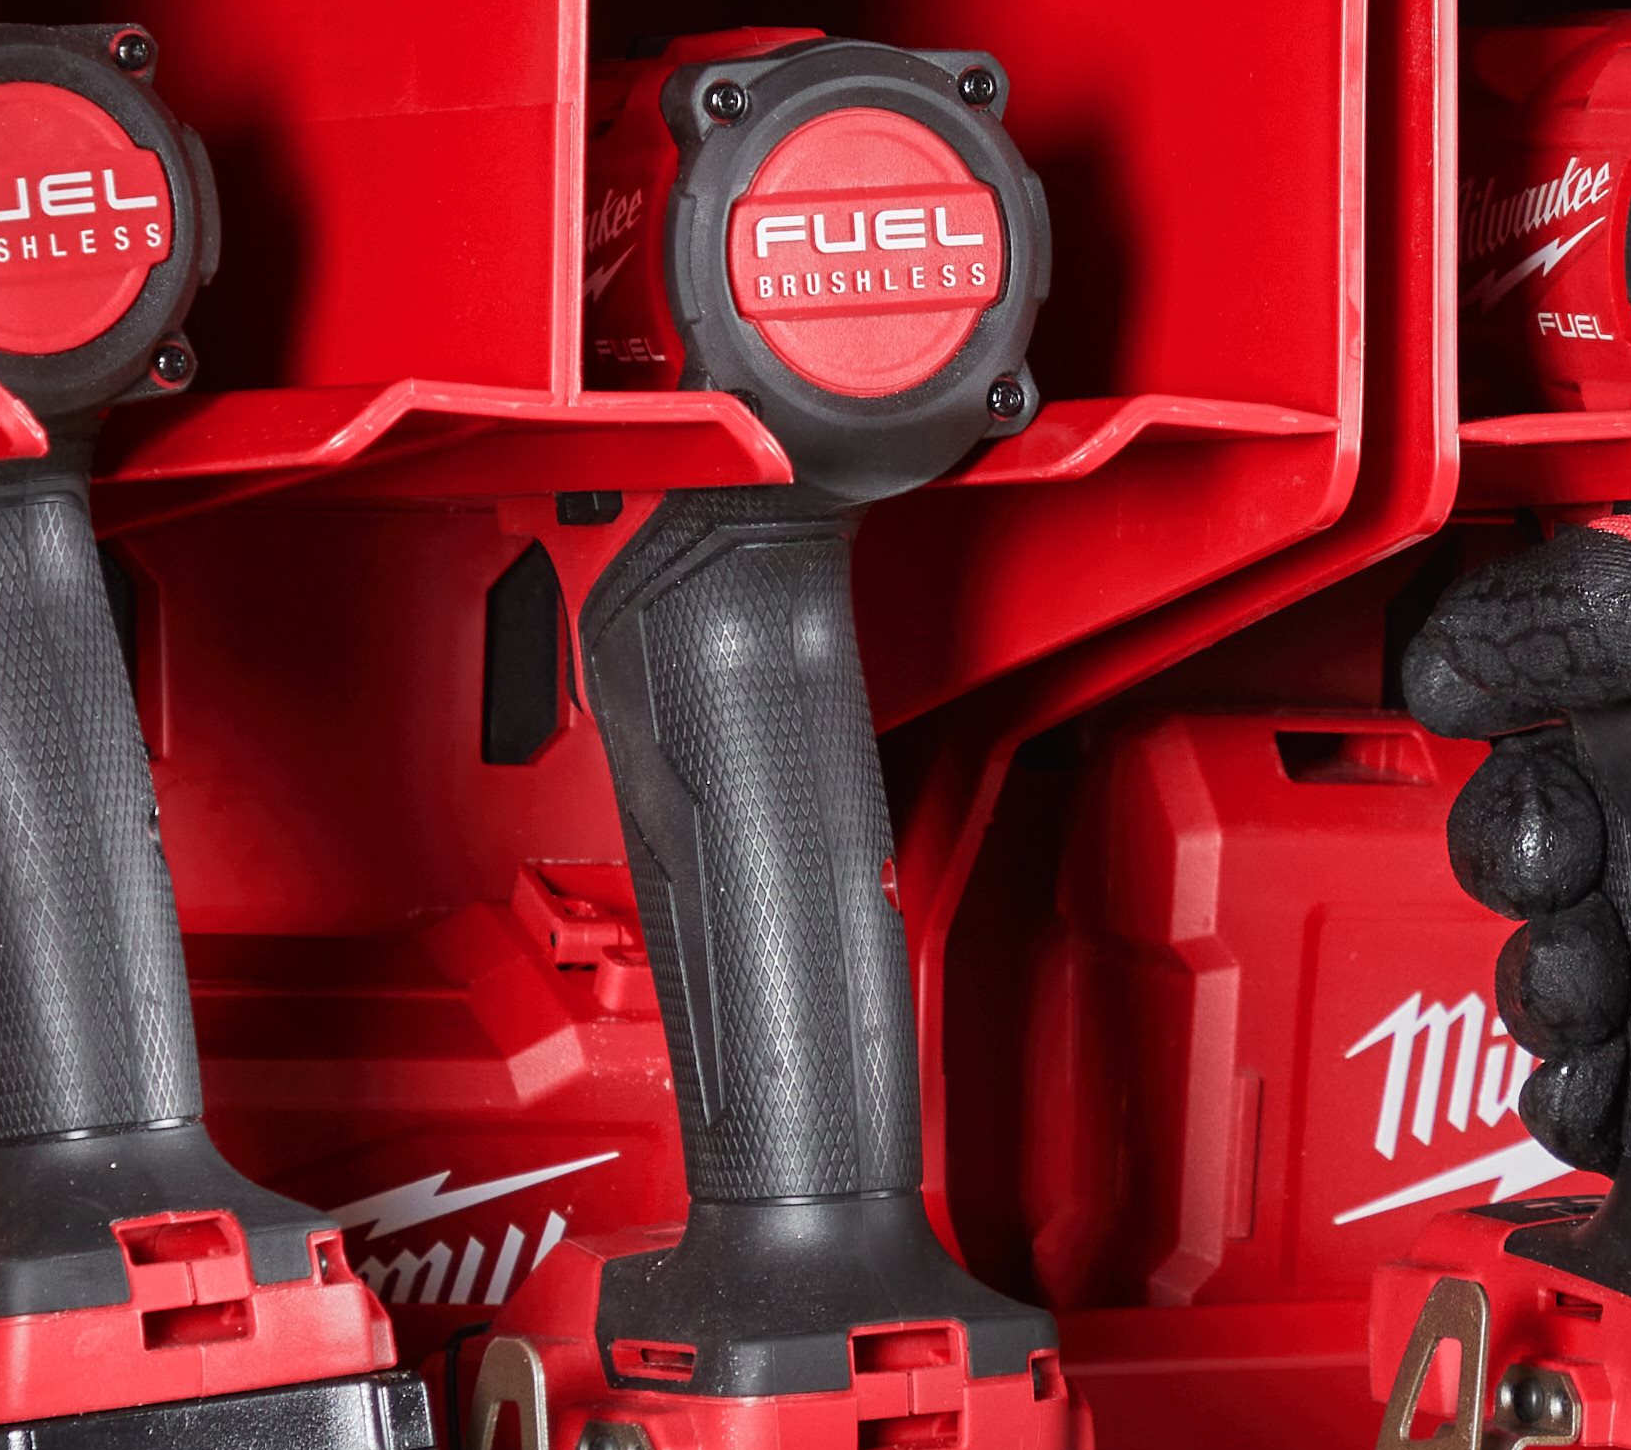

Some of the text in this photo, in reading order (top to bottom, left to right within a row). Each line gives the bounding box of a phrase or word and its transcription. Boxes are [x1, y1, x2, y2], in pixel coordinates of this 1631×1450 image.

[755, 205, 985, 259] FUEL
[758, 261, 987, 300] BRUSHLESS
[1538, 312, 1614, 341] FUEL
[595, 337, 668, 363] FUEL
